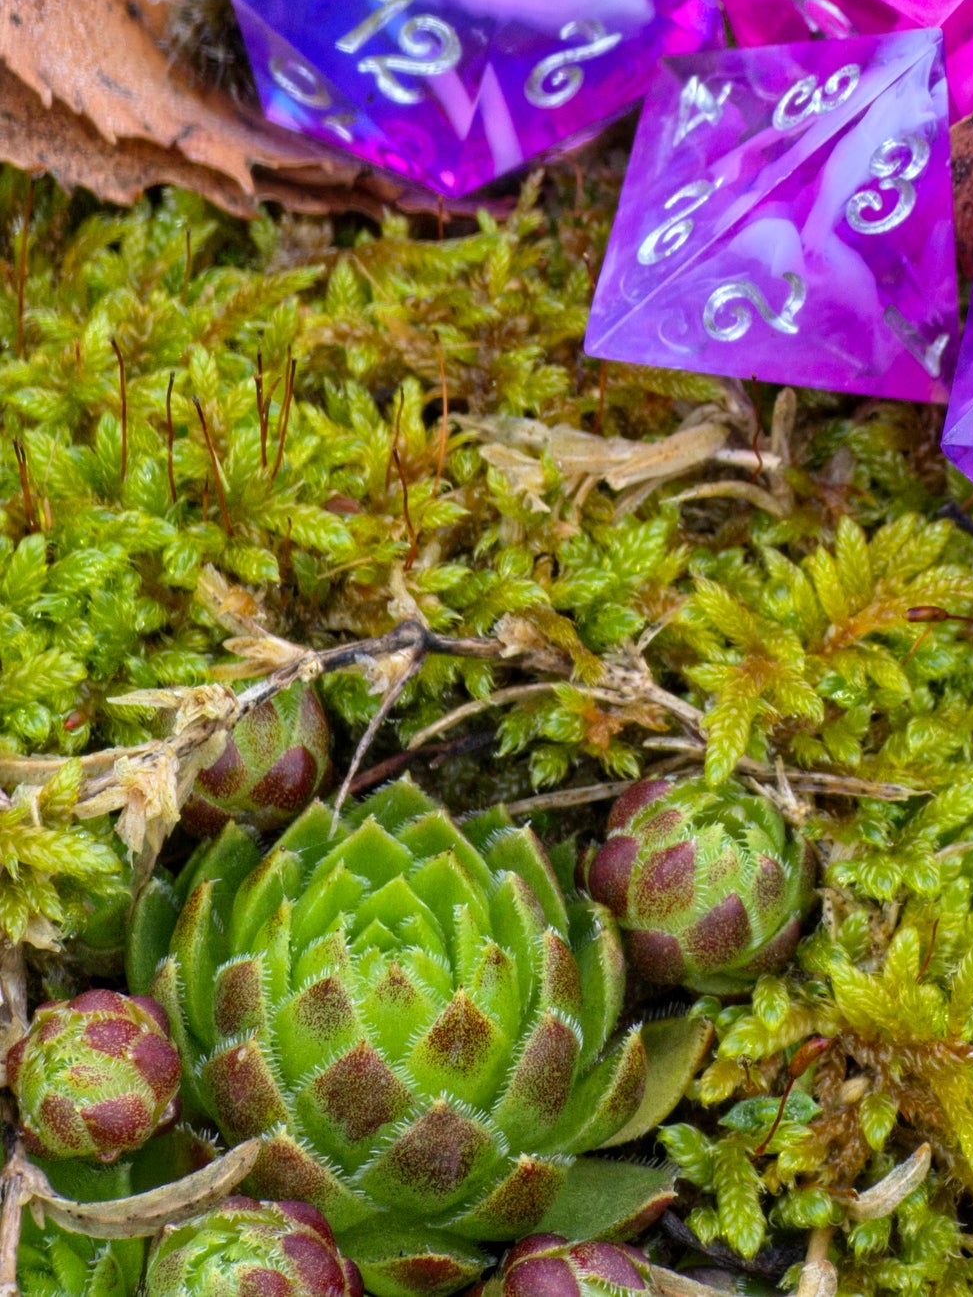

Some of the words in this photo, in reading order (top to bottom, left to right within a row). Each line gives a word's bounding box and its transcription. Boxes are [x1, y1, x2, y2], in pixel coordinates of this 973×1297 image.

[772, 63, 860, 130] 3
[846, 134, 930, 234] 3
[703, 272, 806, 342] 2
